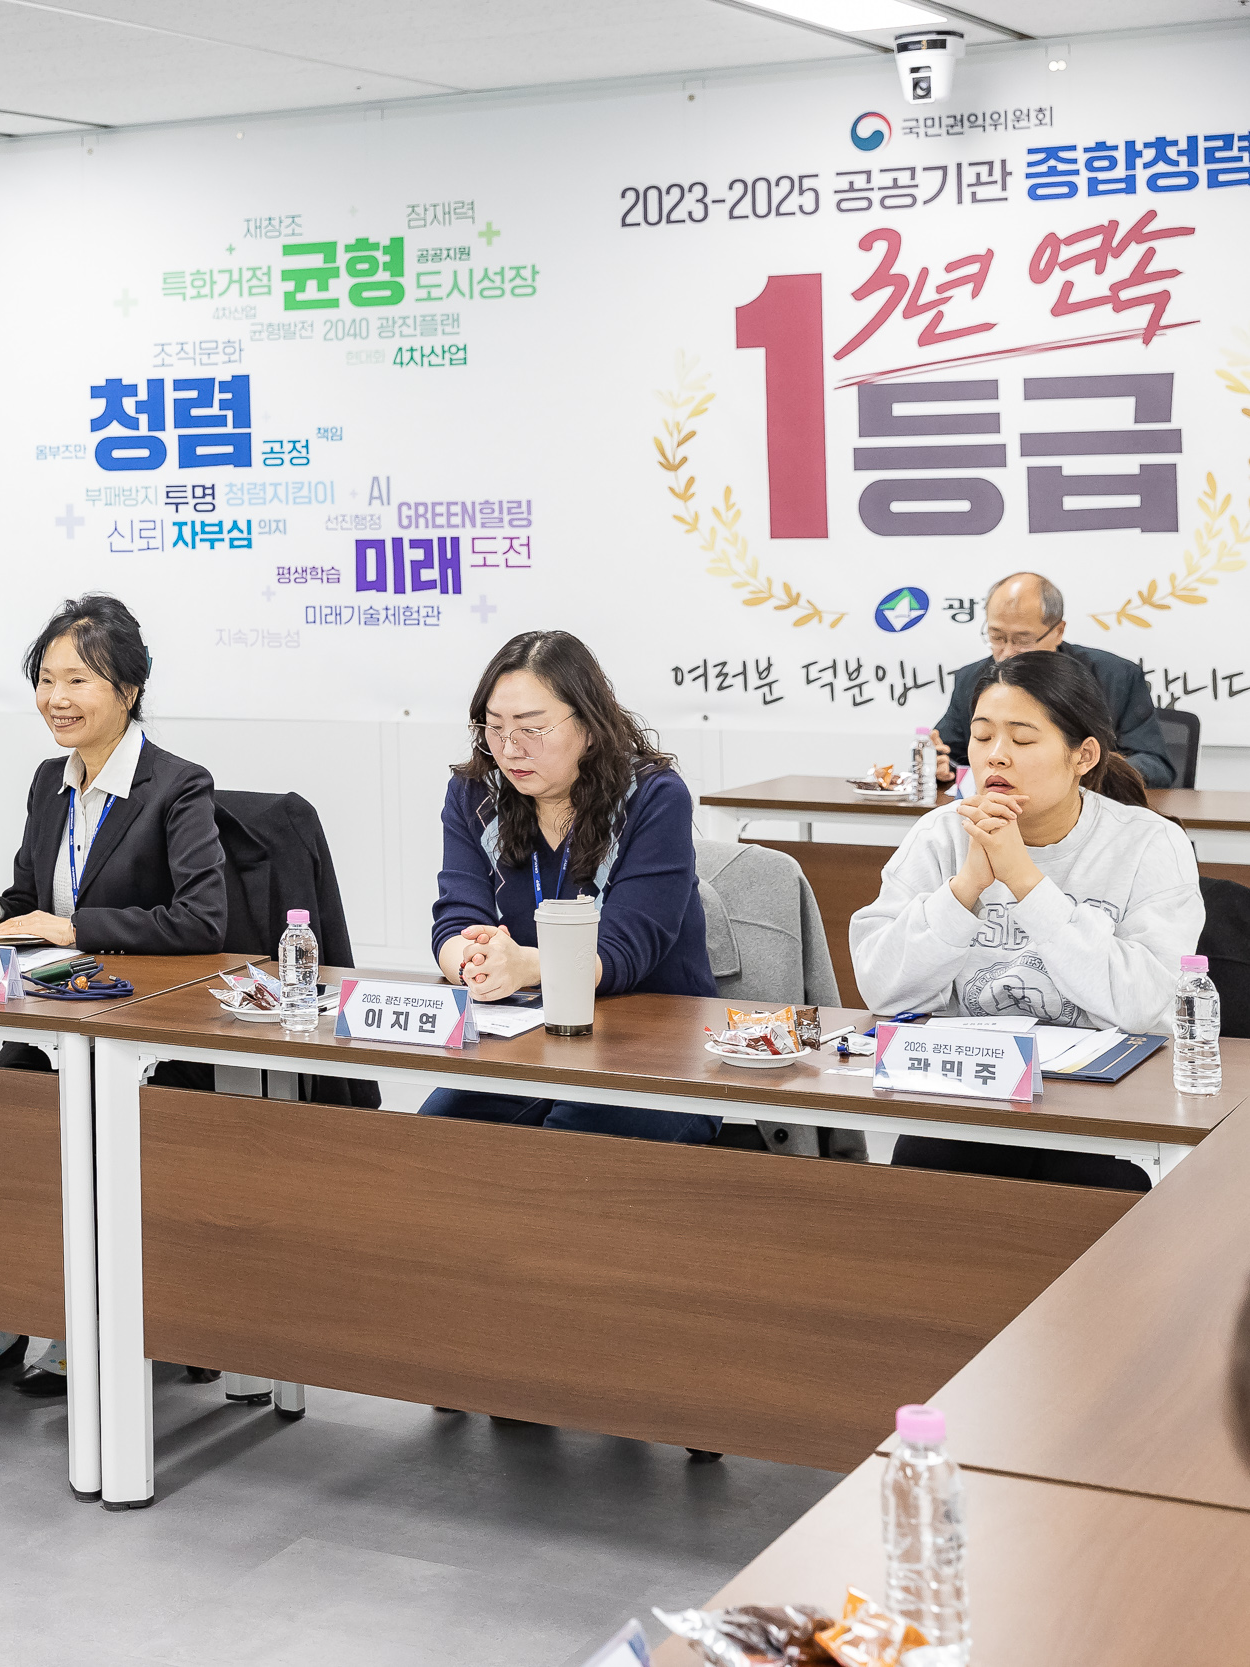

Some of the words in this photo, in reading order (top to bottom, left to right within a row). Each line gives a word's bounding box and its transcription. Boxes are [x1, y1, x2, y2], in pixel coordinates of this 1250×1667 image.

[903, 106, 1052, 138] 국민권익위원회
[621, 174, 819, 227] 2023-2025
[834, 159, 1012, 212] 공공기관
[244, 214, 303, 239] 재창조
[406, 199, 475, 229] 잠재력
[417, 246, 470, 264] 공공지원
[162, 265, 272, 301] 특화거점
[281, 236, 405, 311] 균형
[415, 263, 540, 303] 도시성장
[833, 228, 999, 360] 3년
[1028, 209, 1196, 347] 연속
[249, 319, 314, 341] 균형발전
[323, 317, 369, 341] 2040
[377, 313, 460, 339] 광진플랜
[153, 339, 245, 368] 조직문화
[393, 344, 467, 368] 4차산업
[90, 374, 252, 471] 청렴
[316, 427, 342, 441] 책임
[262, 439, 310, 467] 공정
[86, 485, 158, 507] 부패방지
[165, 484, 216, 513] 투명
[225, 480, 335, 506] 청렴지킴이
[368, 476, 390, 506] AI
[258, 519, 286, 535] 의지
[326, 514, 382, 531] 선진행정
[398, 499, 532, 530] GREEN힐링
[107, 519, 165, 554] 신뢰
[172, 519, 252, 550] 자부심
[355, 537, 462, 594] 미래
[471, 536, 531, 568] 도전
[277, 566, 340, 584] 평생학습
[305, 605, 441, 626] 미래기술체험관
[216, 628, 301, 648] 지속가능성
[672, 657, 784, 705] 여러분
[802, 656, 960, 707] 덕분입니
[362, 993, 381, 1004] 2026.
[385, 995, 401, 1006] 광진
[403, 997, 444, 1010] 주민기자단
[904, 1041, 928, 1053] 2026.
[932, 1043, 952, 1055] 광진
[954, 1045, 1005, 1060] 주민기자단
